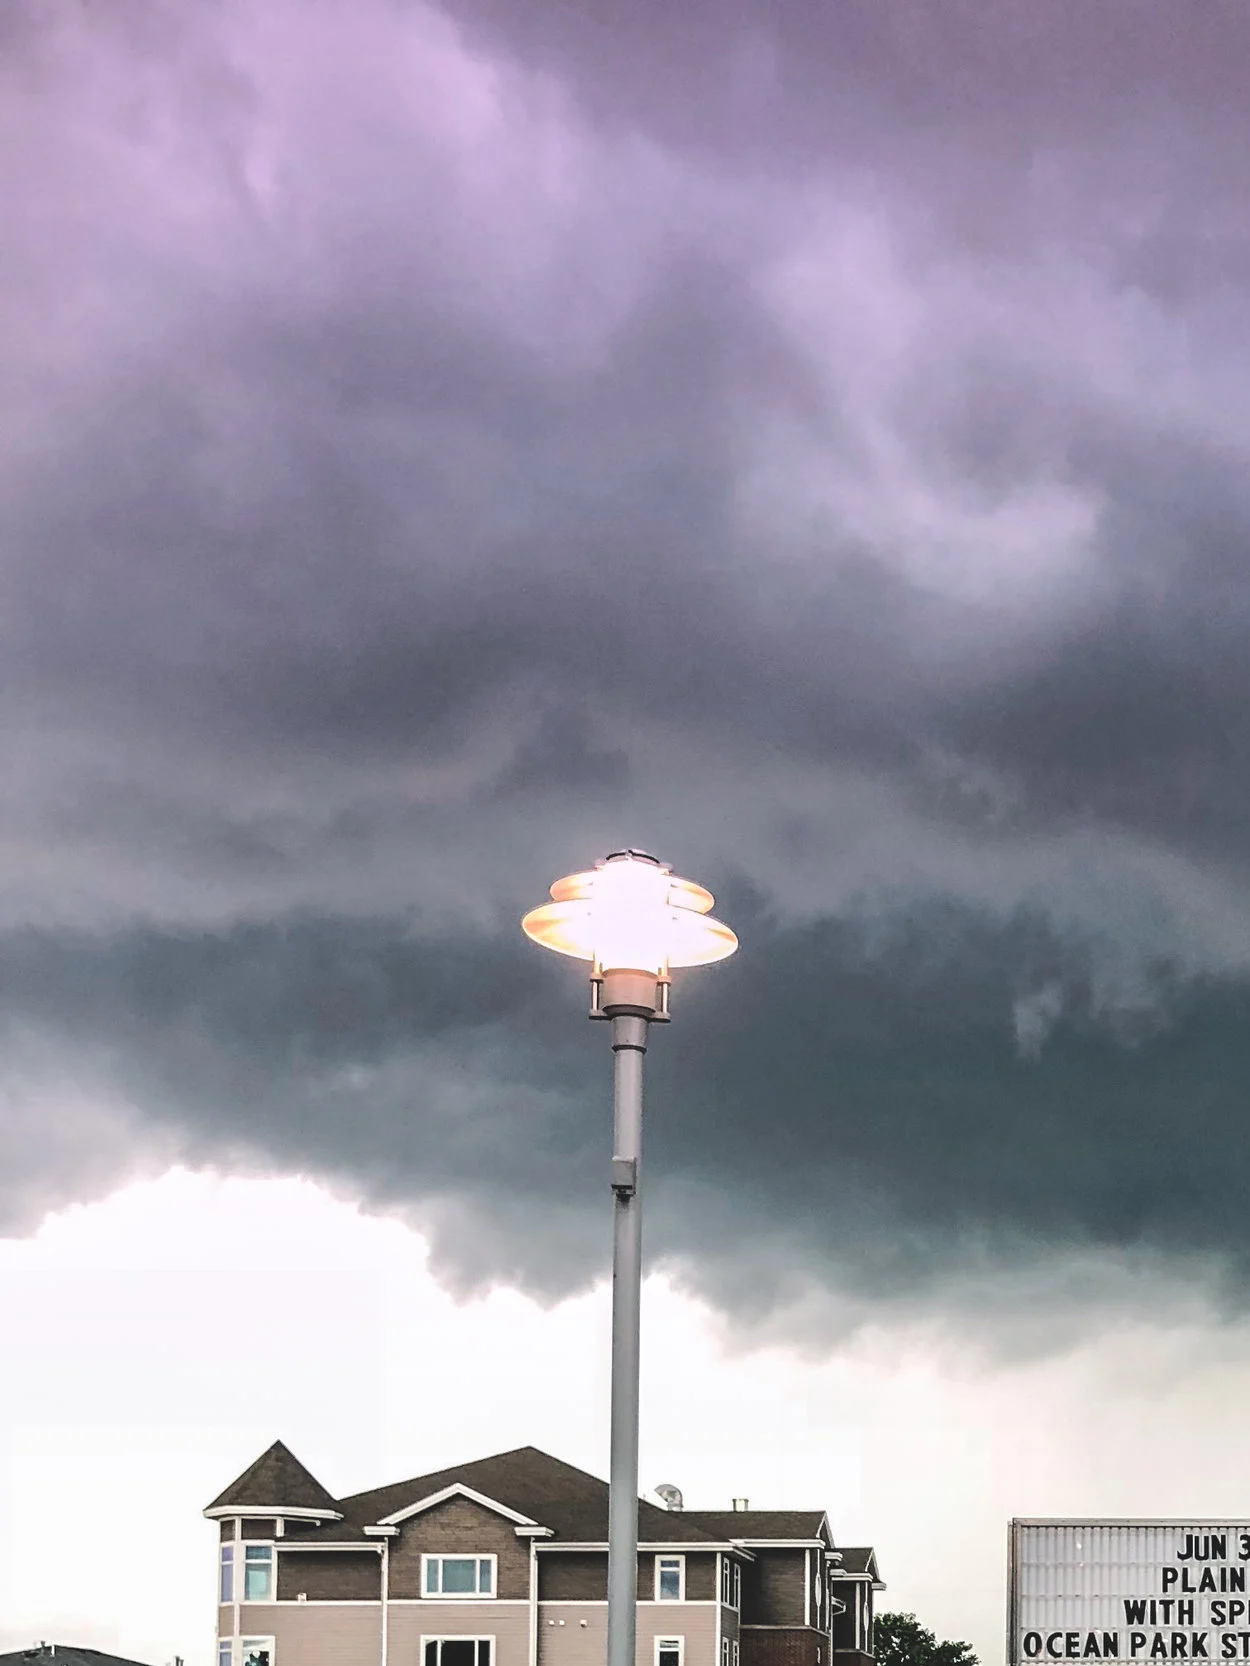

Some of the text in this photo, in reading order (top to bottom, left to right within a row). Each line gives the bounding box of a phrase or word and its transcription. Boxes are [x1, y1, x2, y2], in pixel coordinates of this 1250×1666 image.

[1177, 1534, 1227, 1561] JUN
[1162, 1567, 1245, 1593] PLAIN
[1123, 1599, 1194, 1626] WITH
[1023, 1631, 1119, 1659] OCEAN
[1130, 1632, 1209, 1659] PARK
